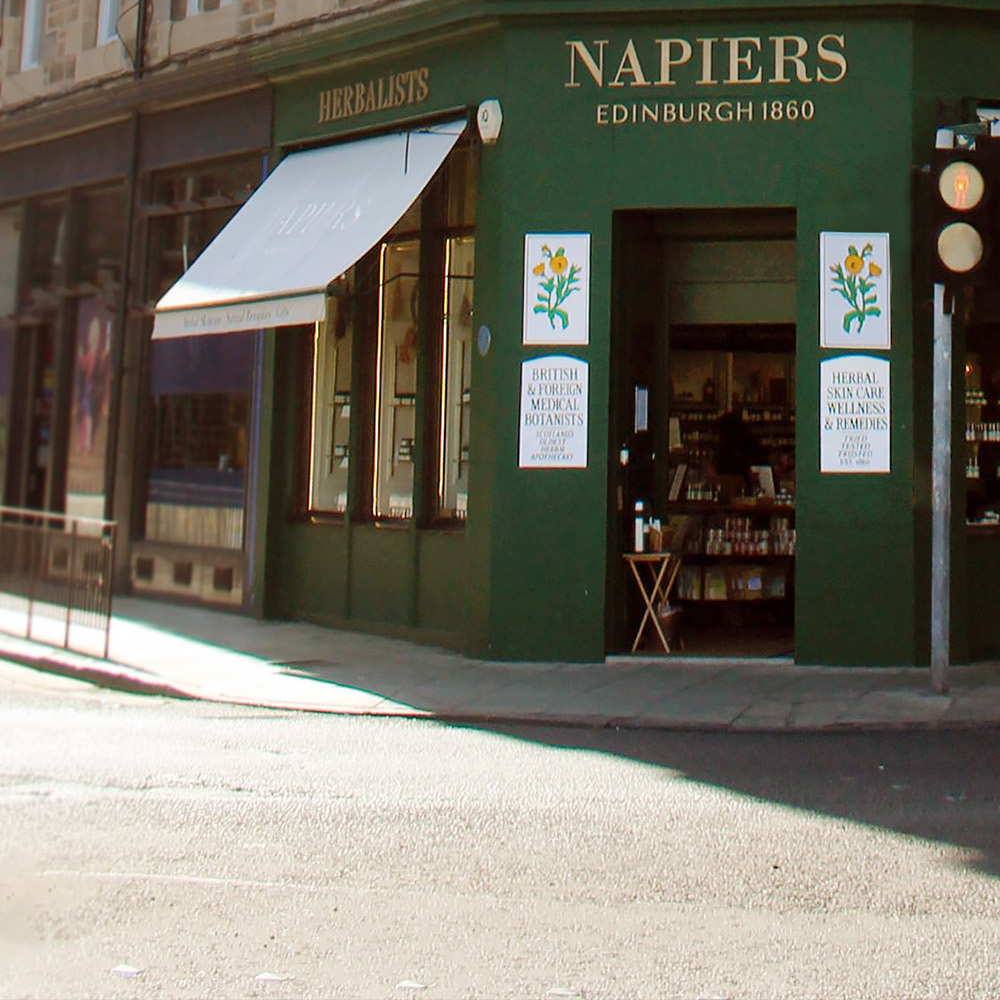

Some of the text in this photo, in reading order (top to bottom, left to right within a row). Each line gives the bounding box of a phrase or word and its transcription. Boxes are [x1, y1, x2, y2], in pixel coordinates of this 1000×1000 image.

[564, 34, 848, 88] NAPIERS
[318, 67, 429, 124] HERBALISTS
[596, 99, 815, 125] EDINBURGH 1860
[532, 368, 578, 381] BRITISH
[832, 371, 879, 385] HERBAL
[527, 382, 583, 396] & FOREIGN
[827, 386, 885, 399] SKIN CARE
[531, 398, 580, 411] MEDICAL
[827, 401, 886, 415] WELLNESS
[524, 412, 584, 426] BOTANISTS
[824, 416, 888, 430] & REMEDIES
